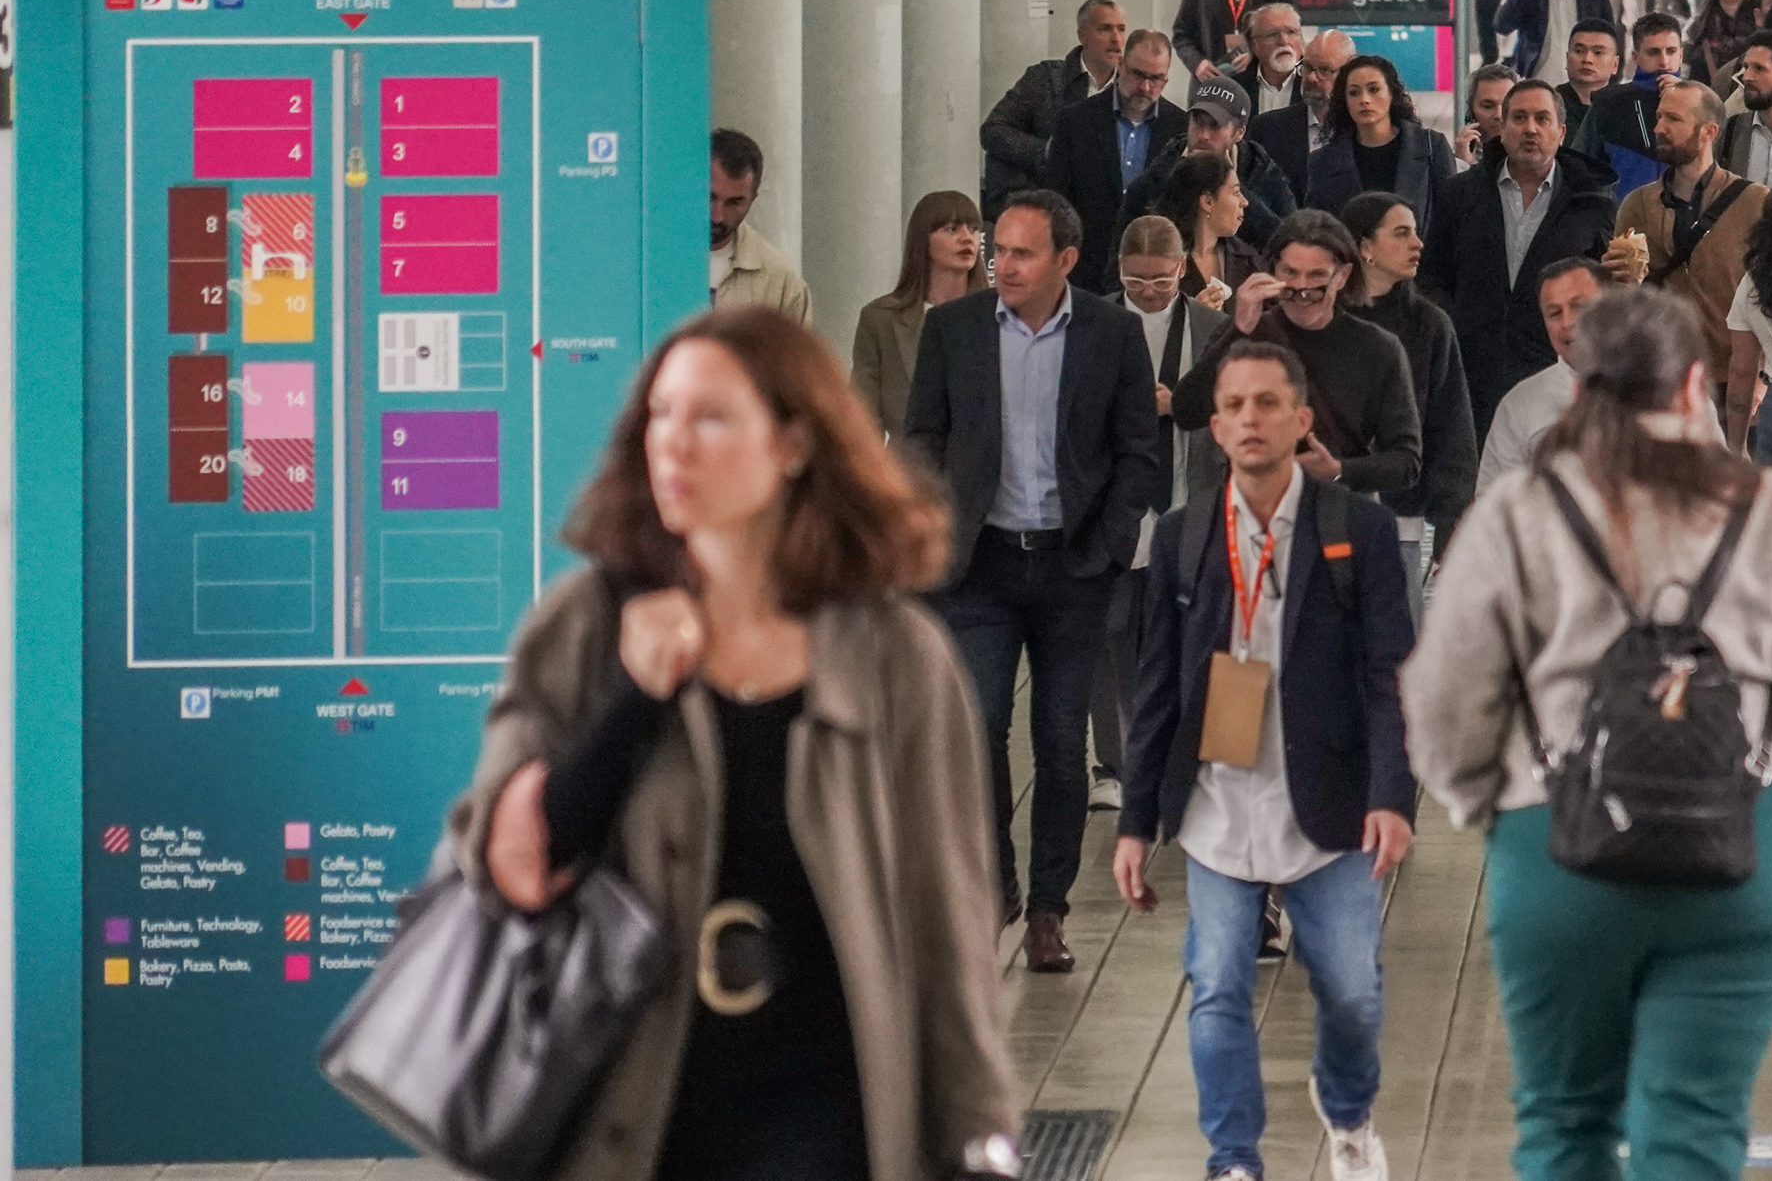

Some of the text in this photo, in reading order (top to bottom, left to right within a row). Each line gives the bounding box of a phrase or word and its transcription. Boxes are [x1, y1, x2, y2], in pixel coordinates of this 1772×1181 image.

[289, 96, 302, 114] 2
[394, 95, 404, 113] 1
[288, 144, 302, 161] 4
[393, 143, 406, 161] 3
[559, 166, 598, 179] Parking
[206, 216, 218, 233] 8
[393, 210, 406, 229] 5
[293, 223, 306, 240] 6
[392, 260, 405, 277] 7
[201, 287, 223, 304] 12
[286, 296, 307, 313] 10
[552, 337, 617, 349] SOUTH GATE
[201, 384, 223, 402] 16
[286, 391, 305, 407] 14
[393, 428, 406, 447] 9
[200, 455, 226, 473] 20
[287, 466, 307, 483] 18
[392, 477, 408, 495] 11
[212, 687, 252, 700] Parking
[439, 683, 479, 697] Parking
[316, 704, 395, 717] WEST GATE
[363, 823, 396, 839] Pastry
[165, 842, 201, 857] Coffee
[183, 876, 216, 891] Pastry
[346, 872, 382, 887] Coffee
[320, 915, 383, 929] Foodservice
[141, 934, 199, 949] Tableware
[320, 954, 377, 969] Foodservic
[140, 973, 173, 988] Pastry
